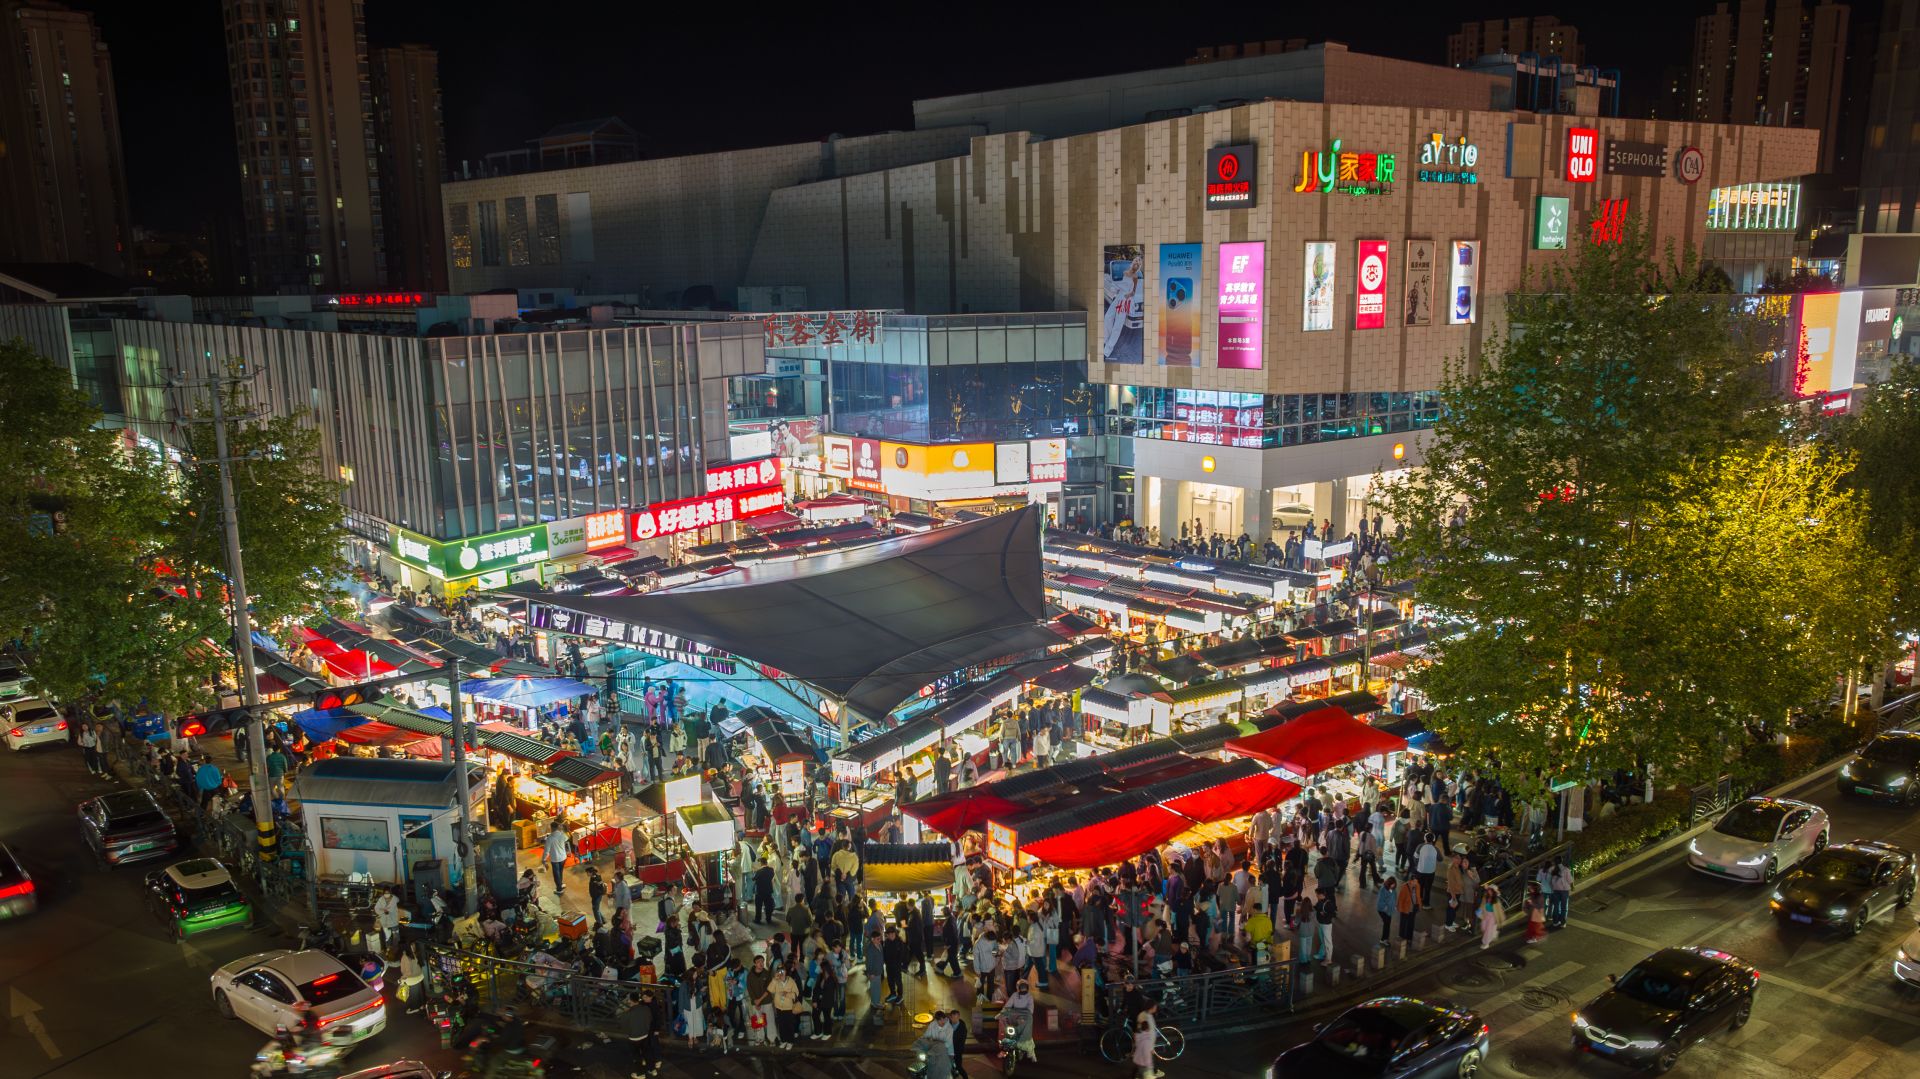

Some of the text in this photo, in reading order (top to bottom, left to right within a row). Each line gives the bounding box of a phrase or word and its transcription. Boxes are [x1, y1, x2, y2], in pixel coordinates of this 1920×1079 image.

[1572, 136, 1592, 155] UNI
[1340, 152, 1396, 183] 家家悦
[1570, 157, 1593, 178] QLO
[1616, 151, 1660, 166] SEPHORA
[1232, 255, 1250, 273] EF
[658, 502, 715, 534] 好想来
